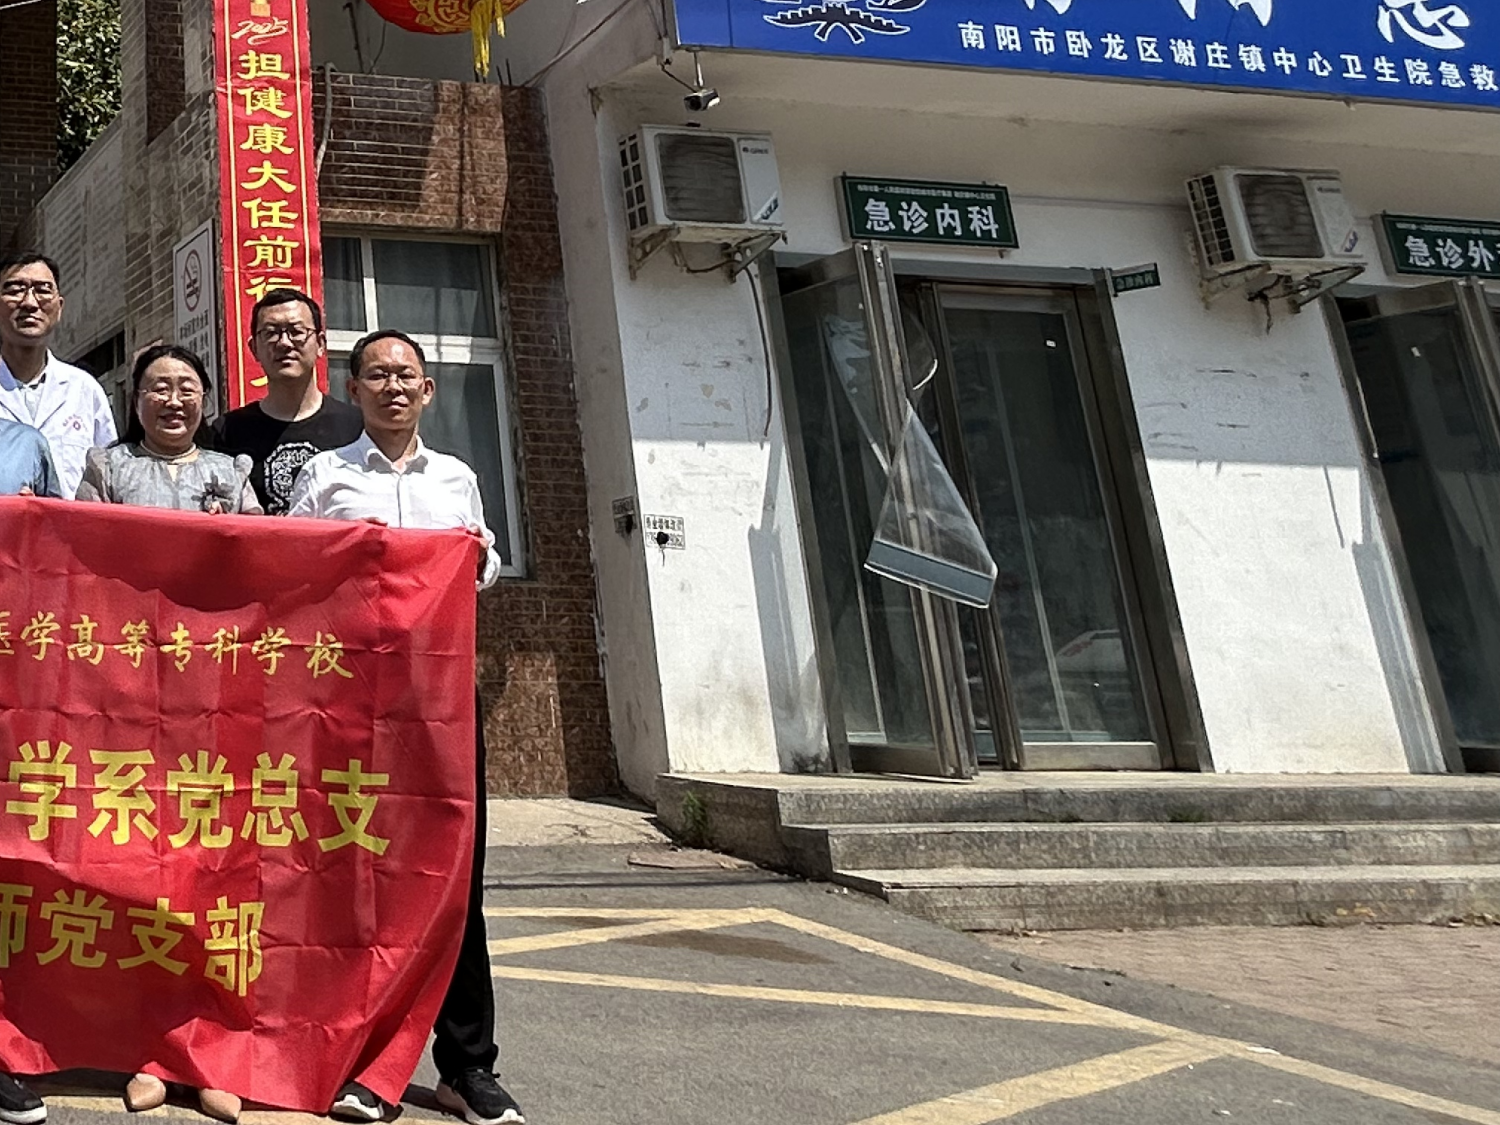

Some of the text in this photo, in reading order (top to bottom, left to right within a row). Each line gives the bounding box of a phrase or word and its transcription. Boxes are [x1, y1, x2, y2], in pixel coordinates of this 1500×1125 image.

[957, 20, 1499, 92] 南阳市卧龙区谢庄镇中心卫生院急救
[864, 197, 1000, 239] 急诊内科
[1405, 235, 1500, 272] 急诊外
